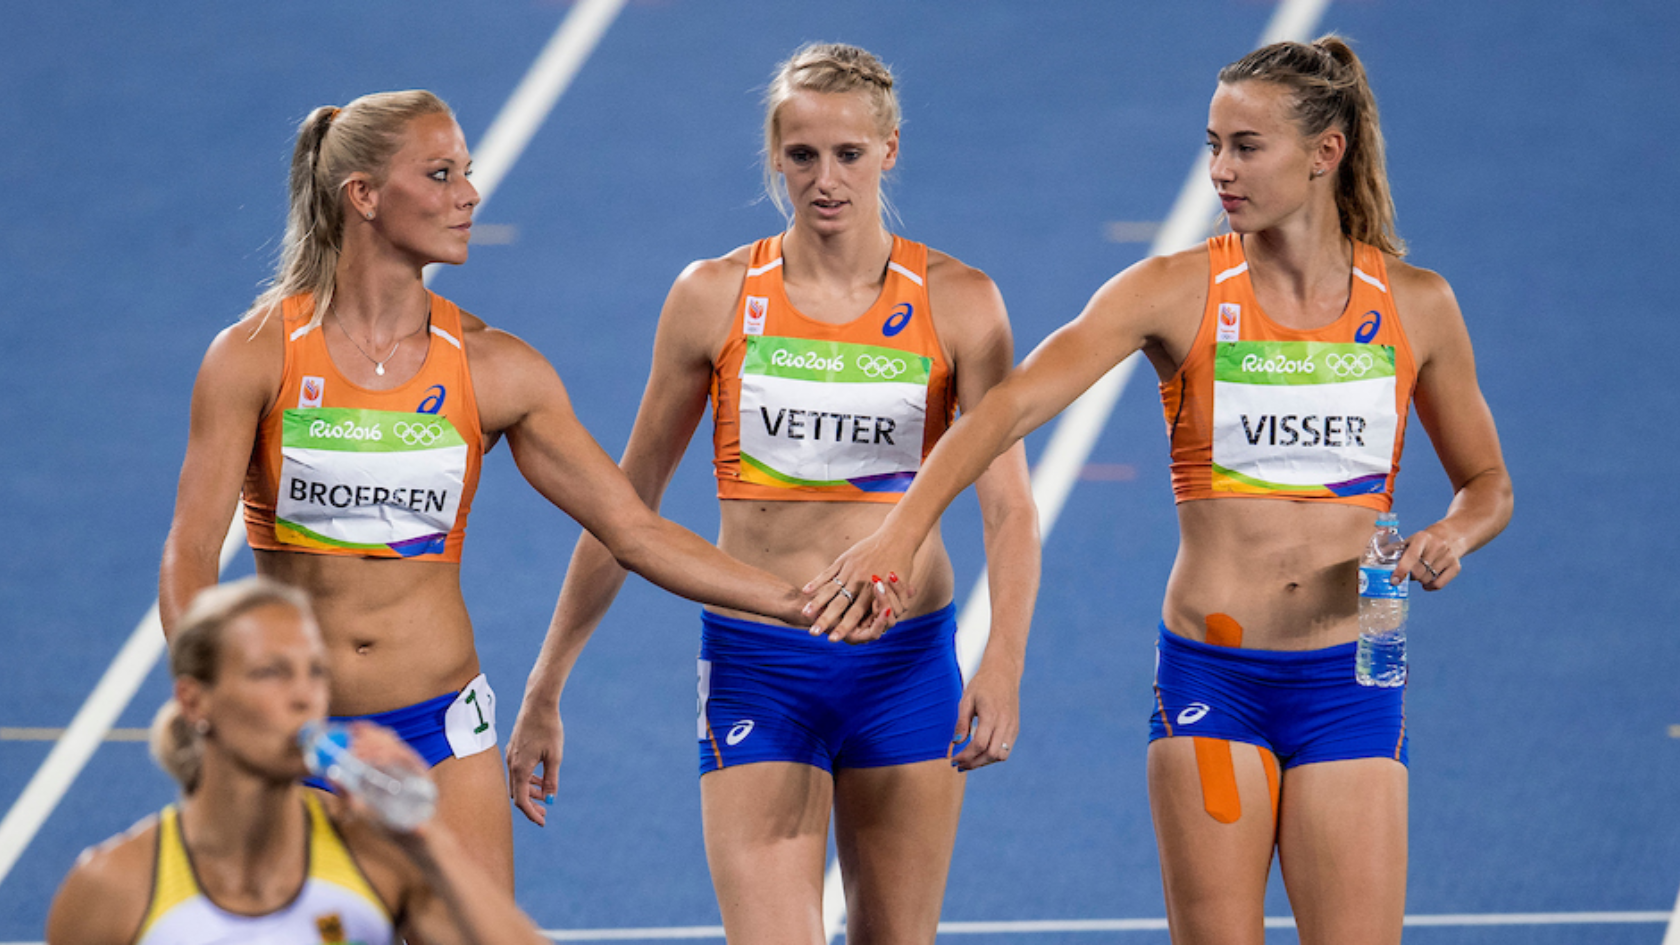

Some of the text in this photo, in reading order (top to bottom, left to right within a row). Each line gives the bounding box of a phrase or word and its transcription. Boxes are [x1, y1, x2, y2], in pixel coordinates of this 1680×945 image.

[771, 349, 845, 371] Rio2016
[1242, 354, 1315, 373] Rio2016
[309, 420, 383, 440] Rio2016
[760, 406, 896, 445] VETTER
[1239, 414, 1367, 447] VISSER
[289, 477, 448, 513] BROERSEN
[465, 689, 492, 735] 1
